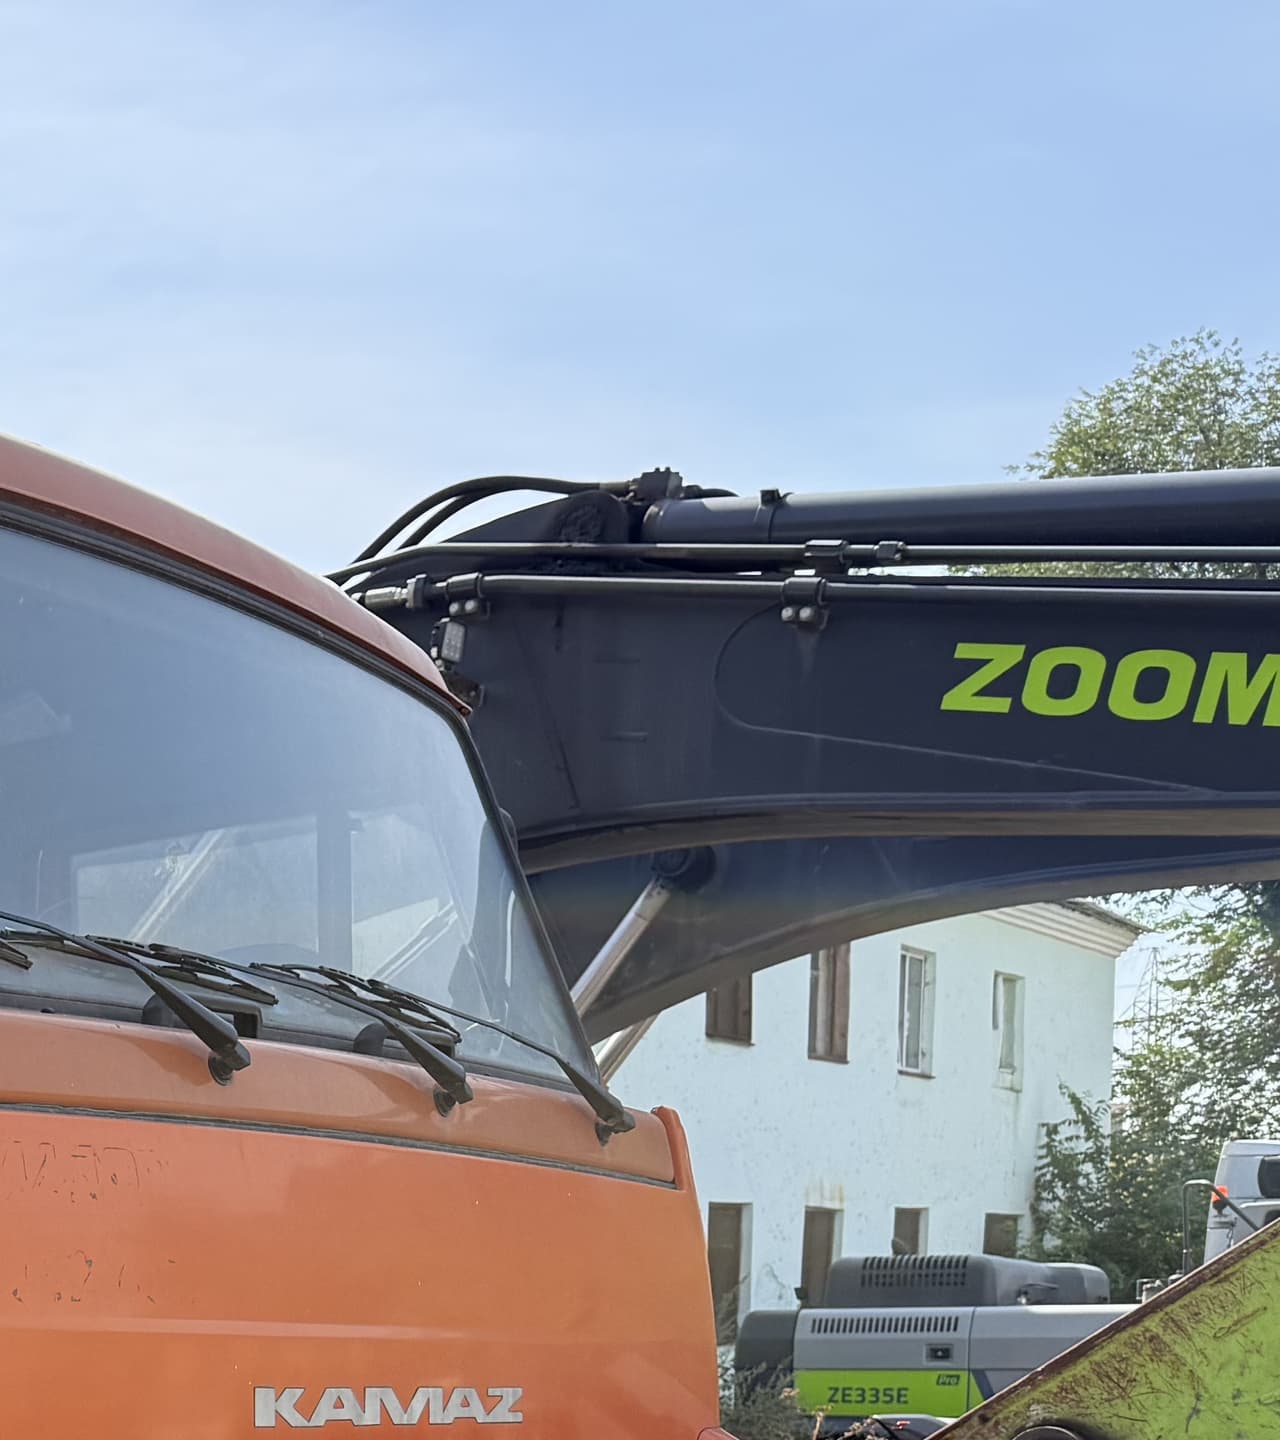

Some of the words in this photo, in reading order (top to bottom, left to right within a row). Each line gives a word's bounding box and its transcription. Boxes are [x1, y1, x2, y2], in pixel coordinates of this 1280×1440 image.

[937, 1374, 959, 1386] Pro
[827, 1386, 910, 1405] ZE335E
[253, 1386, 523, 1428] KAMAZ
